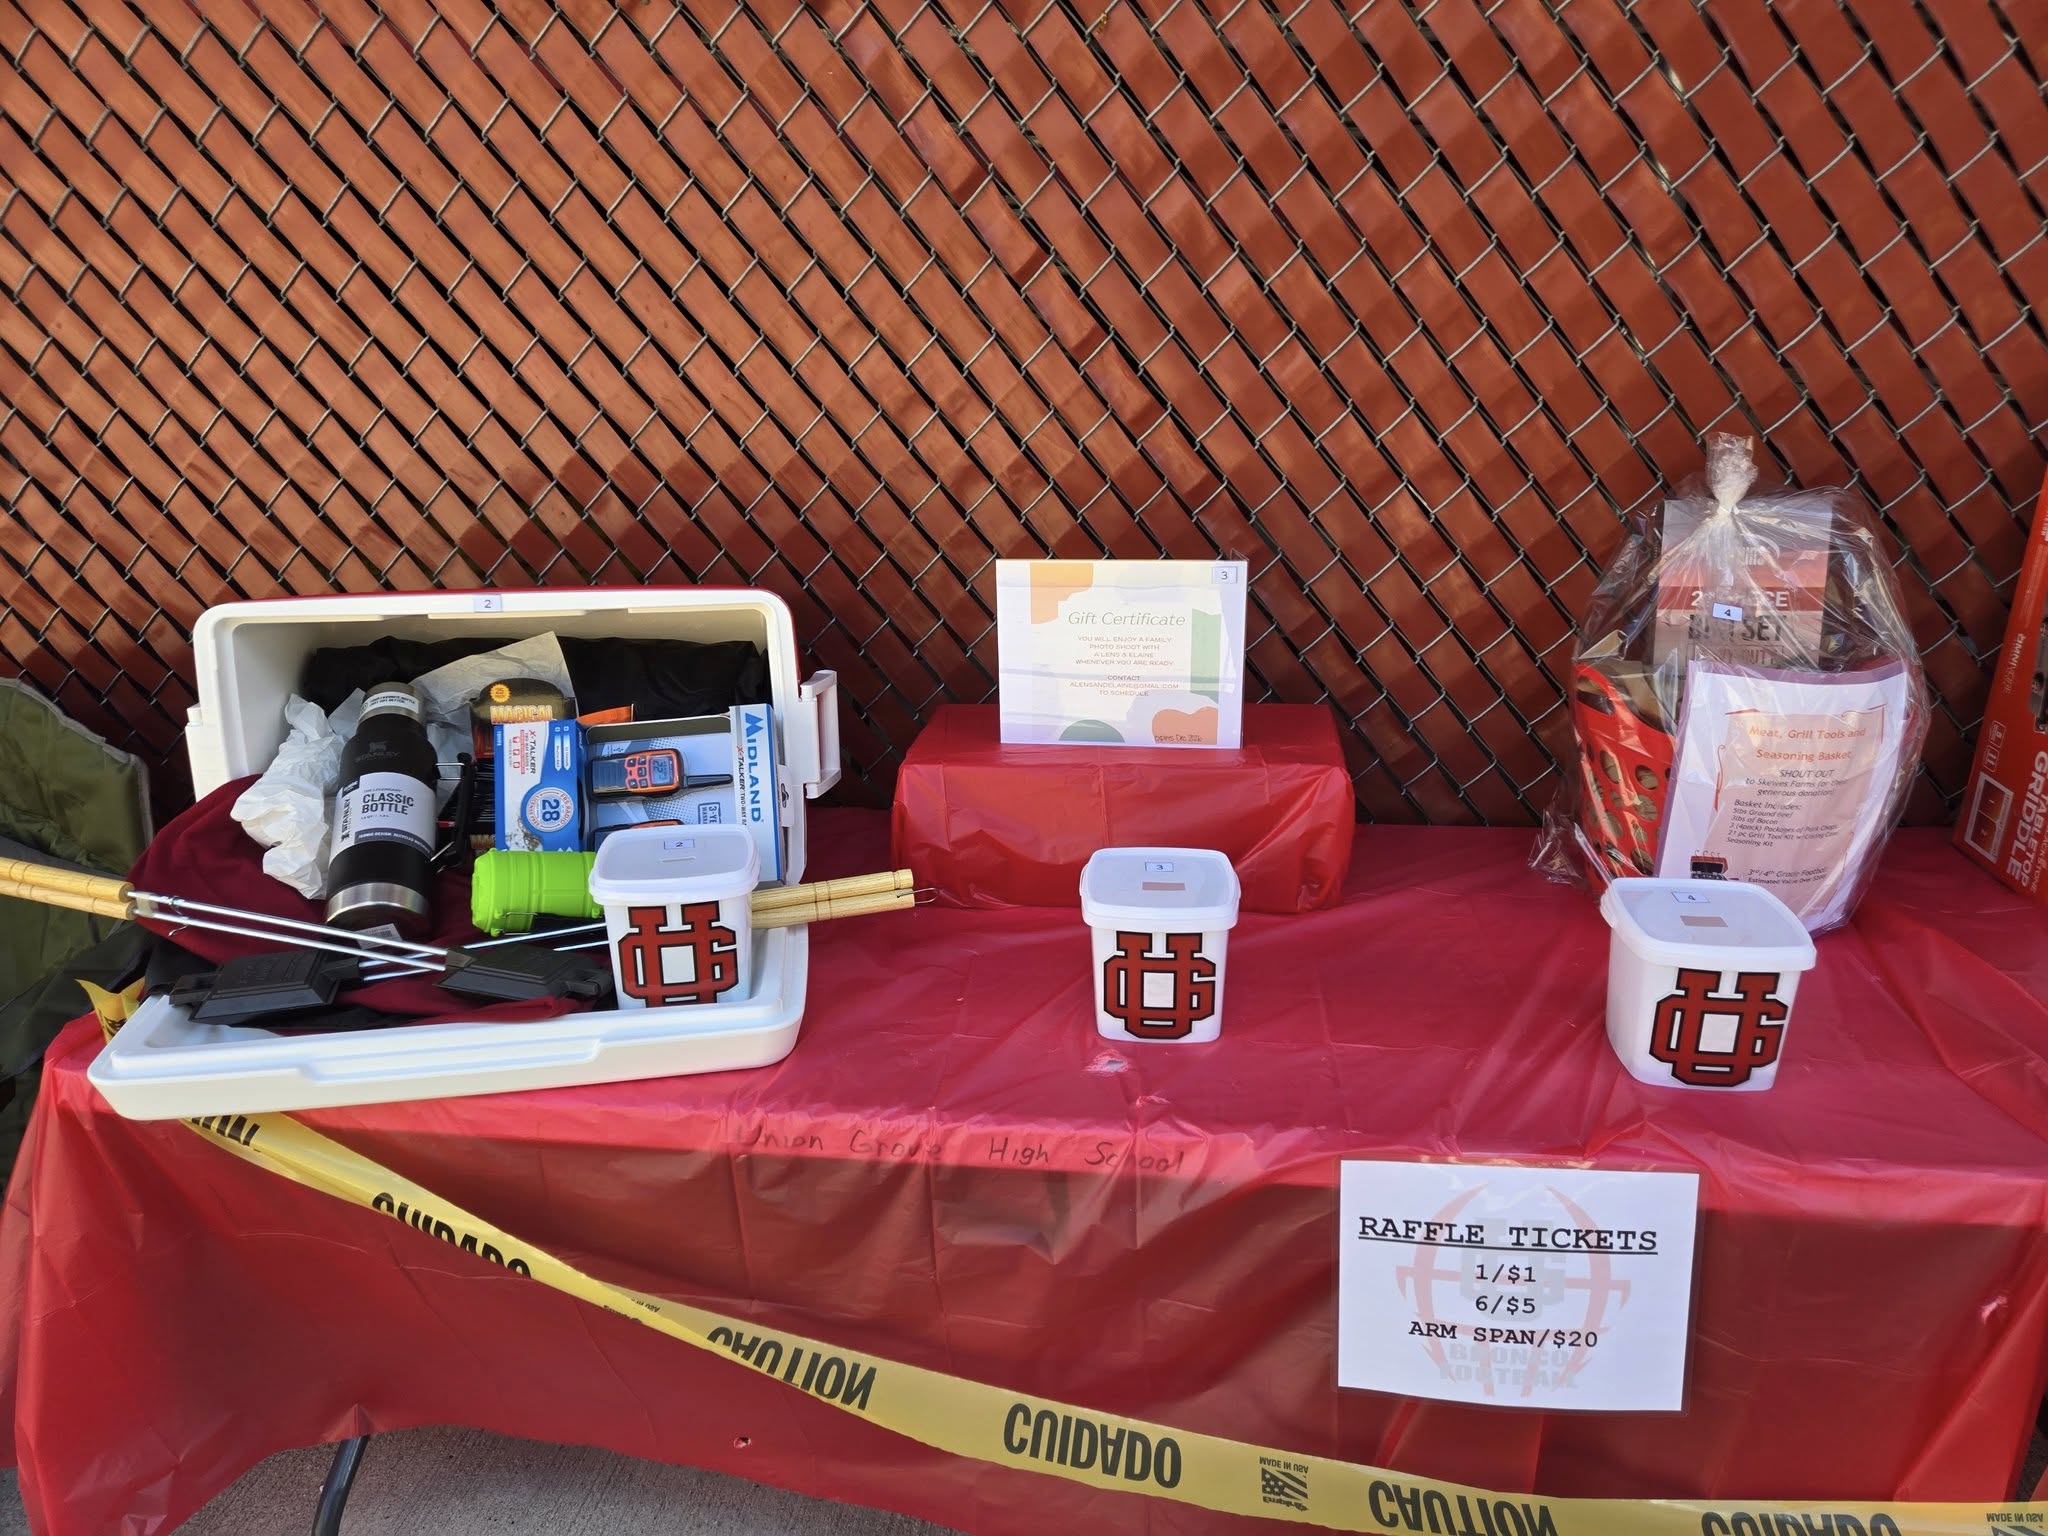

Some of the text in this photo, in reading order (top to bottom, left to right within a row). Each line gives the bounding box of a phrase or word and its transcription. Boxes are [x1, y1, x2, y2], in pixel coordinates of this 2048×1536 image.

[1221, 571, 1229, 580] 3
[483, 599, 492, 609] 2
[1068, 611, 1186, 626] Gift Certificate
[1723, 609, 1732, 617] 4
[1749, 726, 1866, 739] Meat, Grill Tools and
[528, 729, 537, 775] X-TALKER
[1755, 749, 1852, 762] Seasoning Basket
[736, 745, 746, 793] X-TALKER
[744, 712, 764, 823] MIDLAND
[1779, 769, 1836, 778] SHOUT OUT
[1790, 779, 1816, 788] Farms
[362, 792, 414, 807] CLASSIC
[1756, 789, 1796, 797] generous
[361, 802, 409, 815] BOTTLE
[1734, 799, 1762, 808] Basket
[541, 799, 560, 822] 28
[560, 805, 572, 825] RADIO
[1750, 809, 1777, 817] Ground
[2006, 751, 2048, 881] GRIDDLE
[1747, 815, 1756, 824] of
[1756, 816, 1778, 825] Bacon
[1748, 831, 1766, 839] Grill
[1763, 824, 1796, 833] Packages
[1726, 837, 1774, 847] Seasoning Kit
[736, 1124, 1185, 1173] Union Grove High School
[1358, 1216, 1658, 1251] RAFFLE TICKETS
[1475, 1263, 1537, 1284] 1/$1
[1475, 1294, 1536, 1316] 6/$5
[1408, 1321, 1598, 1349] ARM SPAN/$20
[1449, 1344, 1574, 1368] BRONCO
